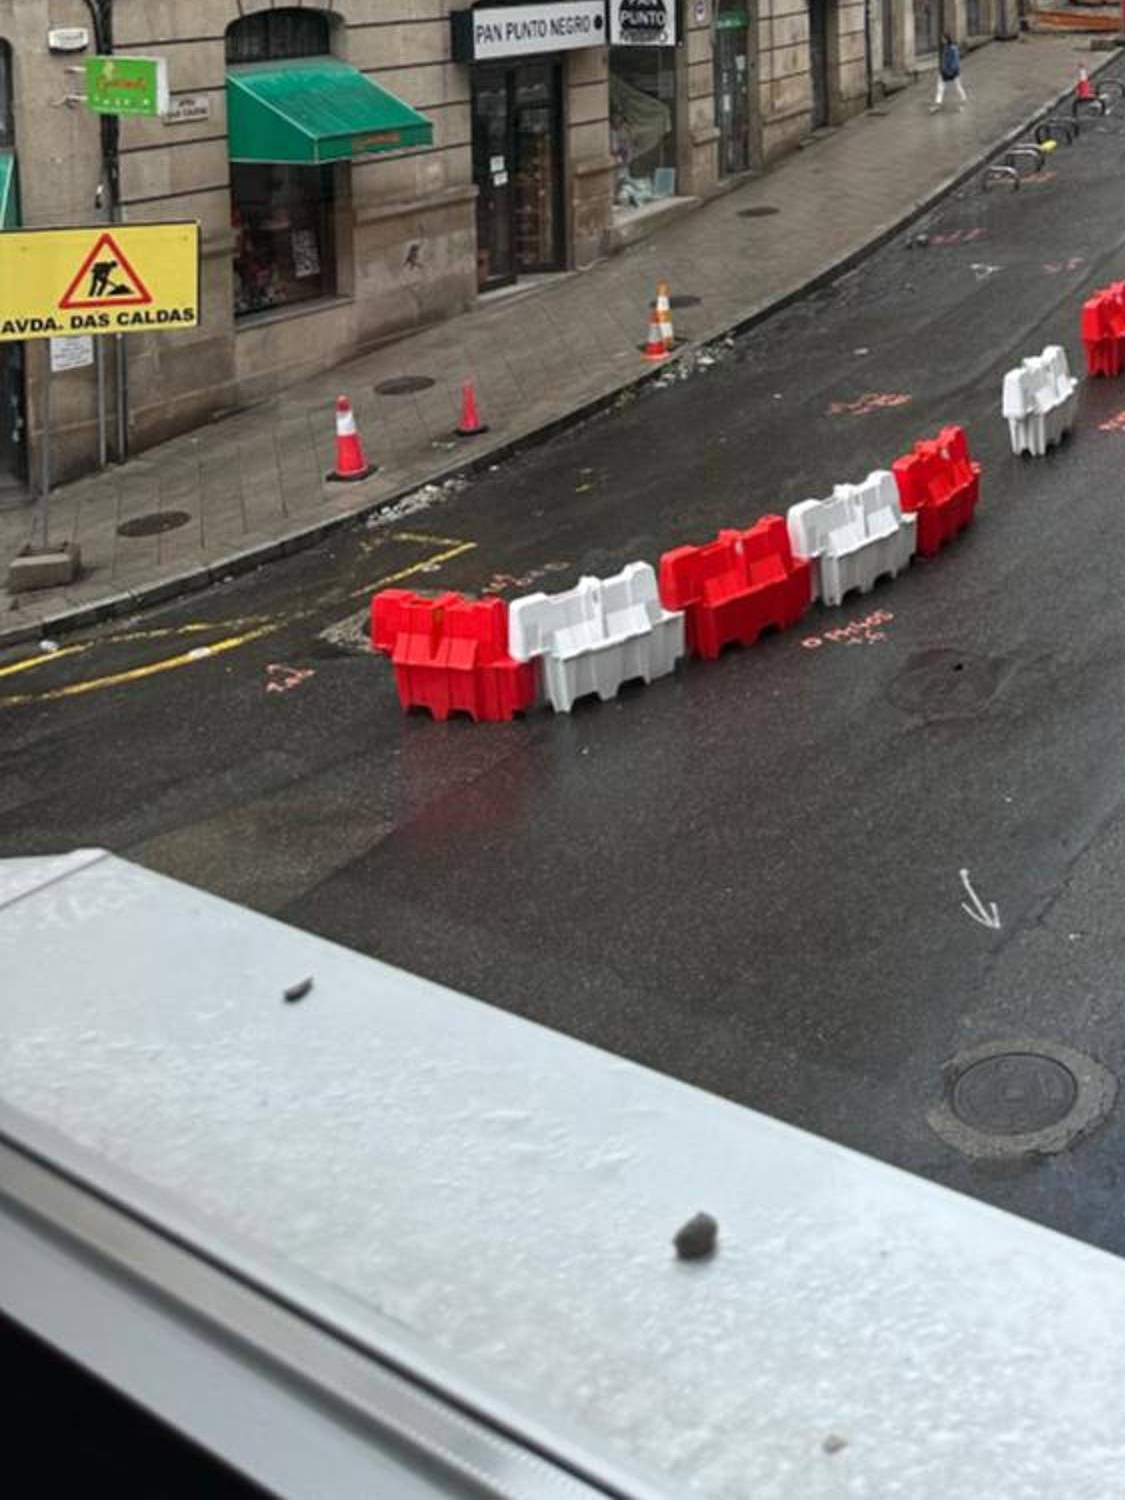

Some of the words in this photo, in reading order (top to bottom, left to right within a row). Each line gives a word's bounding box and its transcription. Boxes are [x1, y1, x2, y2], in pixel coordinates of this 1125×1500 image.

[475, 23, 502, 44] PAN
[506, 18, 548, 40] PUNTO
[550, 14, 591, 36] NEGRO
[619, 10, 667, 27] PUNTO
[2, 317, 64, 334] AVDA.
[70, 313, 110, 329] DAS
[116, 308, 195, 326] CALDAS
